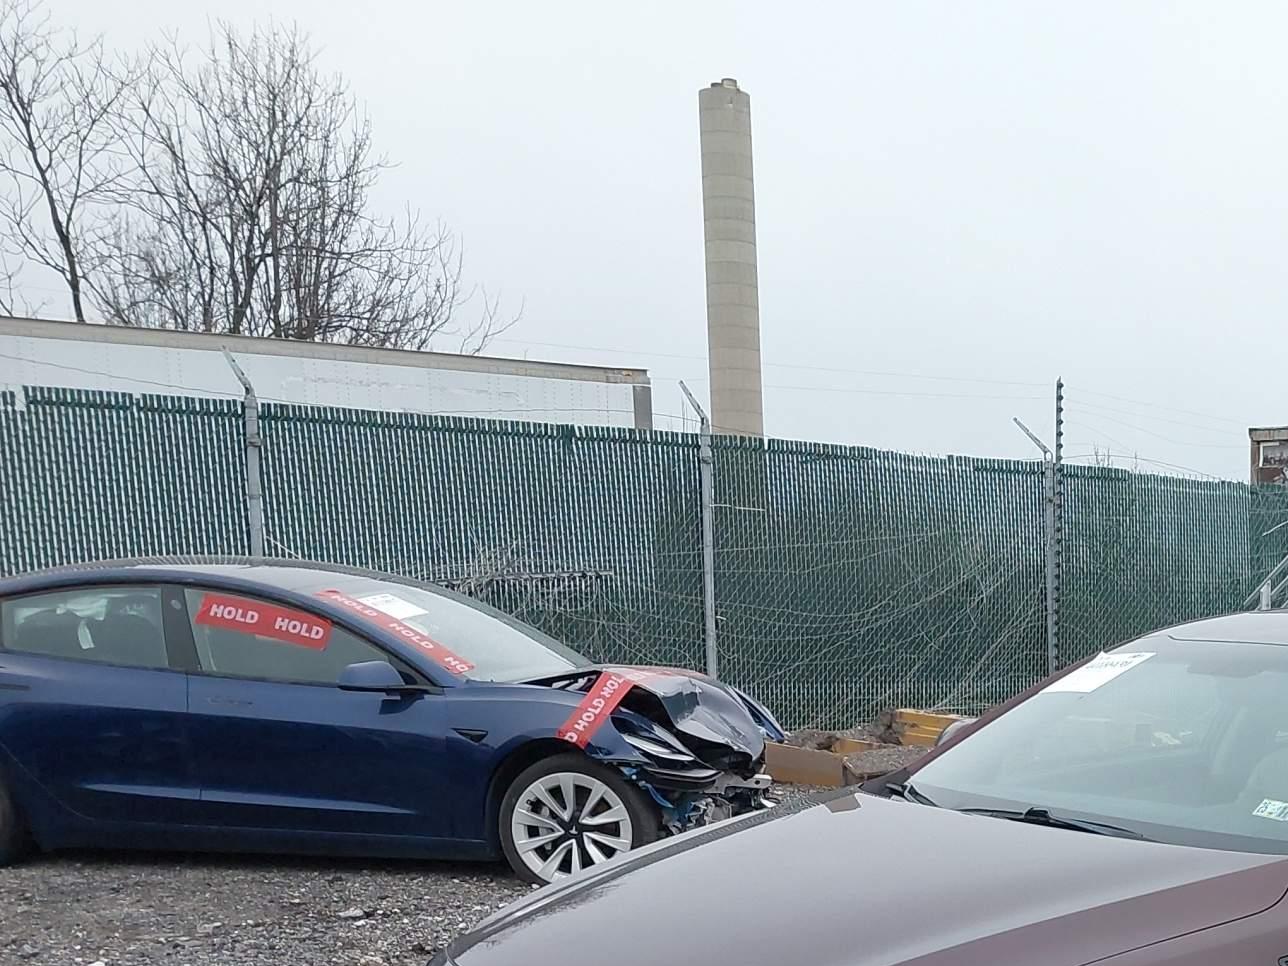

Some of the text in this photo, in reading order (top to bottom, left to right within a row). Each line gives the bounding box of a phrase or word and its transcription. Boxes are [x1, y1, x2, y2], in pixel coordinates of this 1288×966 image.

[209, 603, 324, 640] HOLD HOLD
[330, 595, 378, 617] HOLD
[388, 623, 434, 649] HOLD
[573, 698, 606, 732] HOLD
